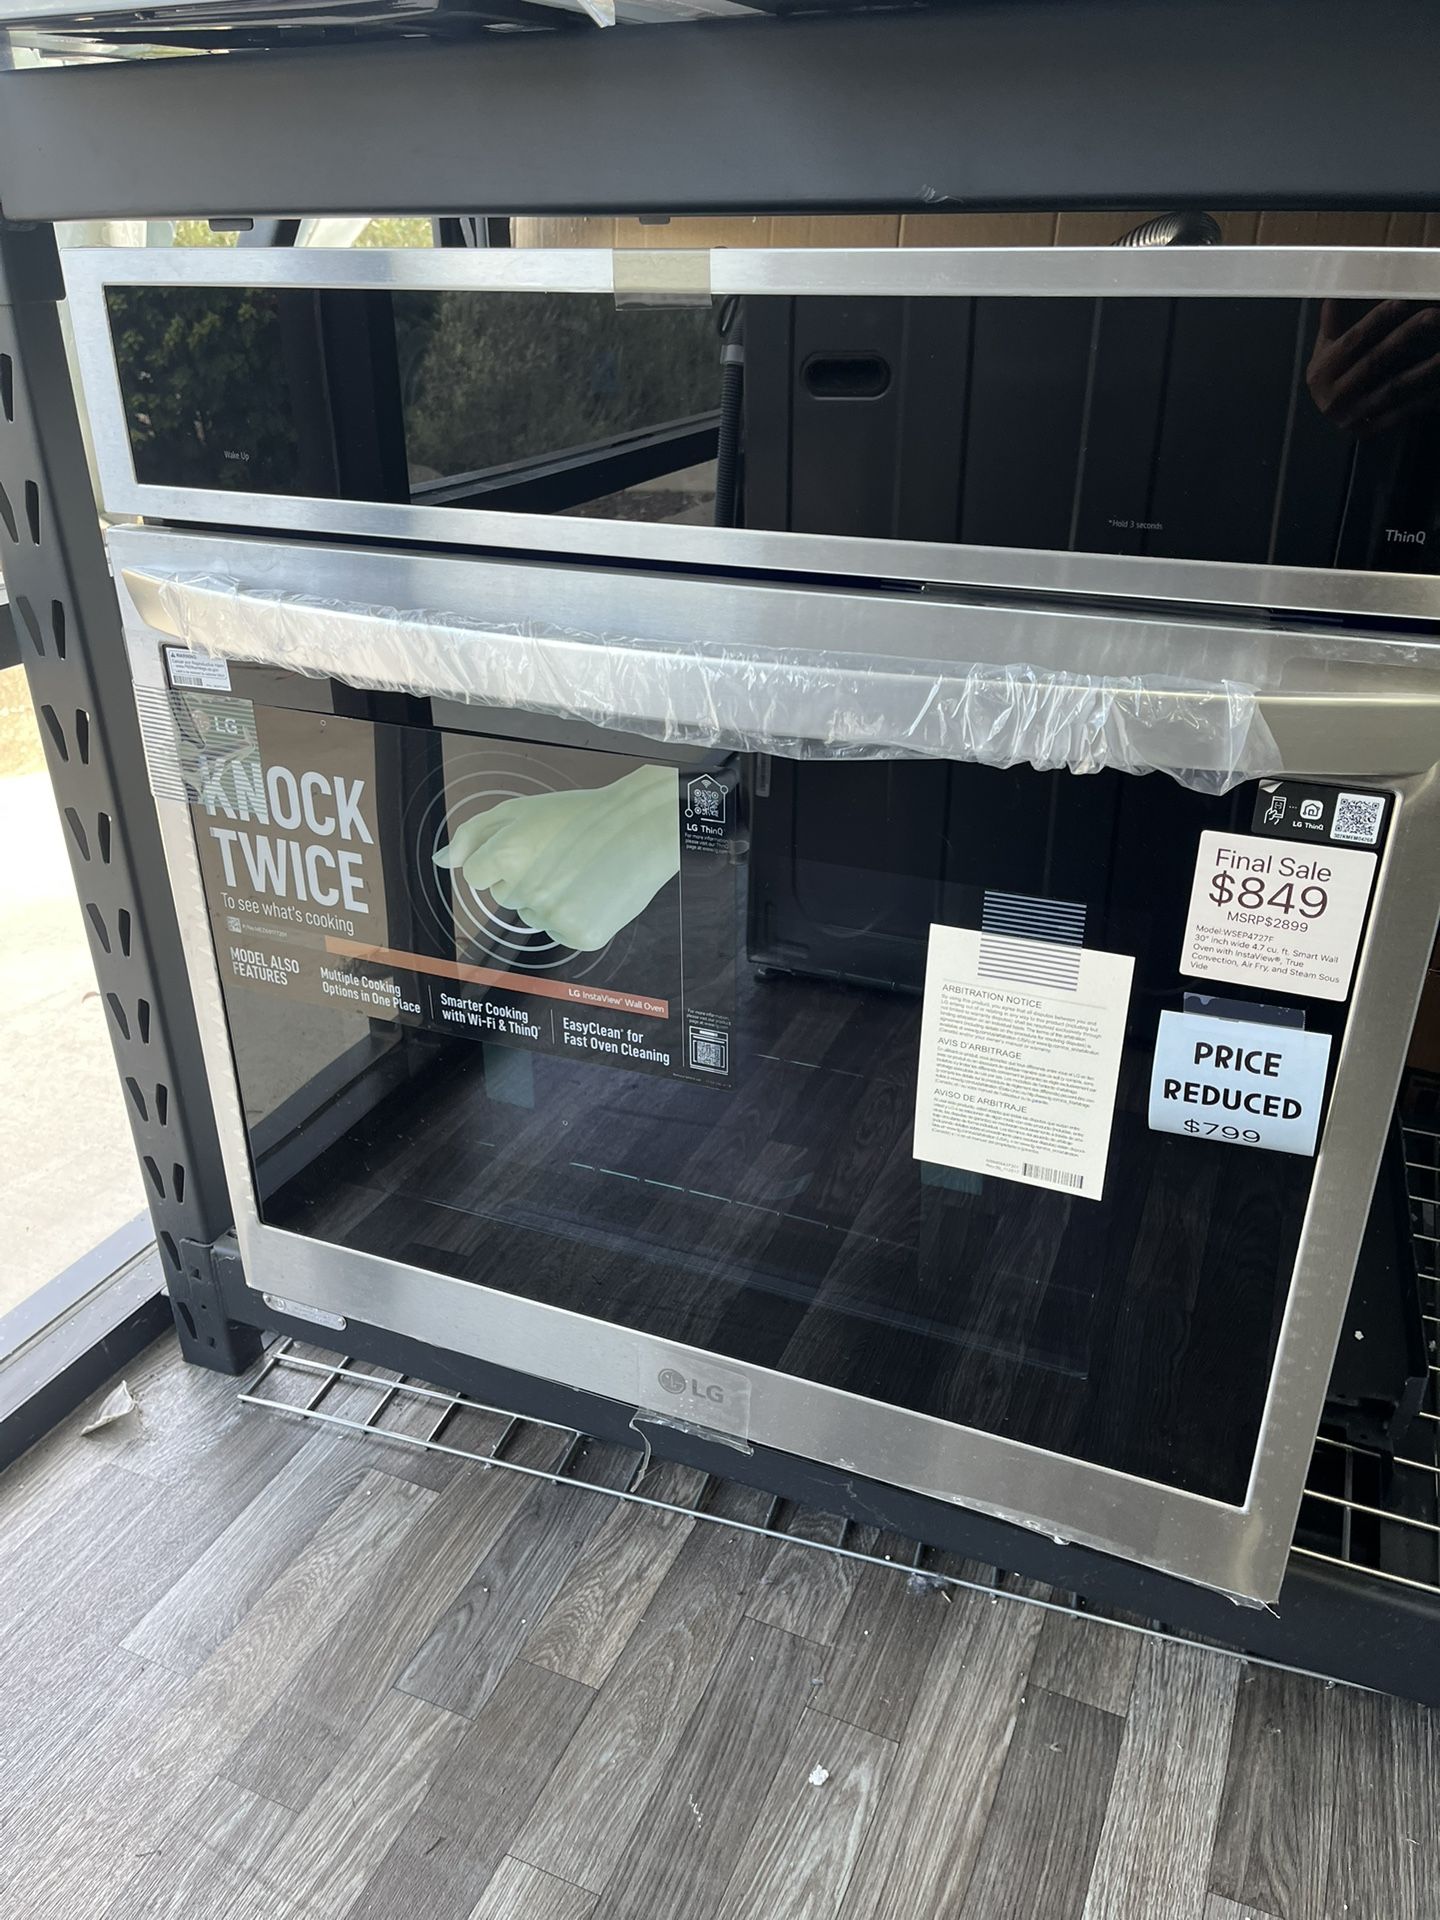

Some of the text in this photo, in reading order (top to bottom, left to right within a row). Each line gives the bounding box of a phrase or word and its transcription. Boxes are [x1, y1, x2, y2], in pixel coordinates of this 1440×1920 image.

[240, 452, 249, 461] Up
[1136, 522, 1162, 530] seconds
[1385, 529, 1426, 544] ThinQ
[214, 716, 238, 734] LG
[201, 757, 374, 845] KNOCK
[686, 823, 724, 836] LG ThinQ
[1304, 822, 1324, 830] ThinQ
[209, 826, 370, 914] TWICE
[1215, 848, 1332, 883] Final Sale
[1208, 870, 1328, 919] $849
[220, 892, 235, 909] To
[238, 897, 260, 914] see
[262, 900, 303, 923] what's
[305, 909, 354, 936] cooking
[1227, 911, 1309, 933] MSRP$2899
[1196, 925, 1275, 943] Model:WSEP4727F
[230, 946, 300, 974] MODEL ALSO
[1193, 943, 1214, 952] Oven
[1216, 946, 1234, 956] with
[1286, 958, 1304, 968] True
[1211, 936, 1228, 946] inch
[1230, 940, 1250, 949] wide
[1252, 943, 1265, 951] 4.7
[1293, 950, 1318, 960] Smart
[1321, 954, 1339, 964] Wall
[233, 962, 288, 986] FEATURES
[1190, 961, 1208, 970] Vide
[1192, 952, 1340, 983] Convection, Air Fry, and Steam Sous
[320, 967, 401, 997] Multiple Cooking
[322, 981, 421, 1014] Options in One Place
[440, 992, 529, 1024] Smarter Cooking
[568, 988, 580, 998] LG
[625, 998, 642, 1008] Wall
[644, 1002, 665, 1013] Oven
[942, 983, 1042, 1008] ARBITRATION NOTICE
[442, 1008, 466, 1024] with
[467, 1012, 496, 1030] Wi-Fi
[498, 1018, 507, 1032] &
[564, 1032, 670, 1066] Fast Oven Cleaning
[627, 1029, 644, 1044] for
[938, 1036, 958, 1047] AVIS
[960, 1040, 1022, 1060] D'ARBITRAGE
[1194, 1042, 1282, 1078] PRICE
[934, 1087, 1027, 1113] AVISO DE ARBITRAJE
[1163, 1079, 1302, 1119] REDUCED
[1184, 1118, 1260, 1144] $799
[692, 1379, 724, 1403] LG
